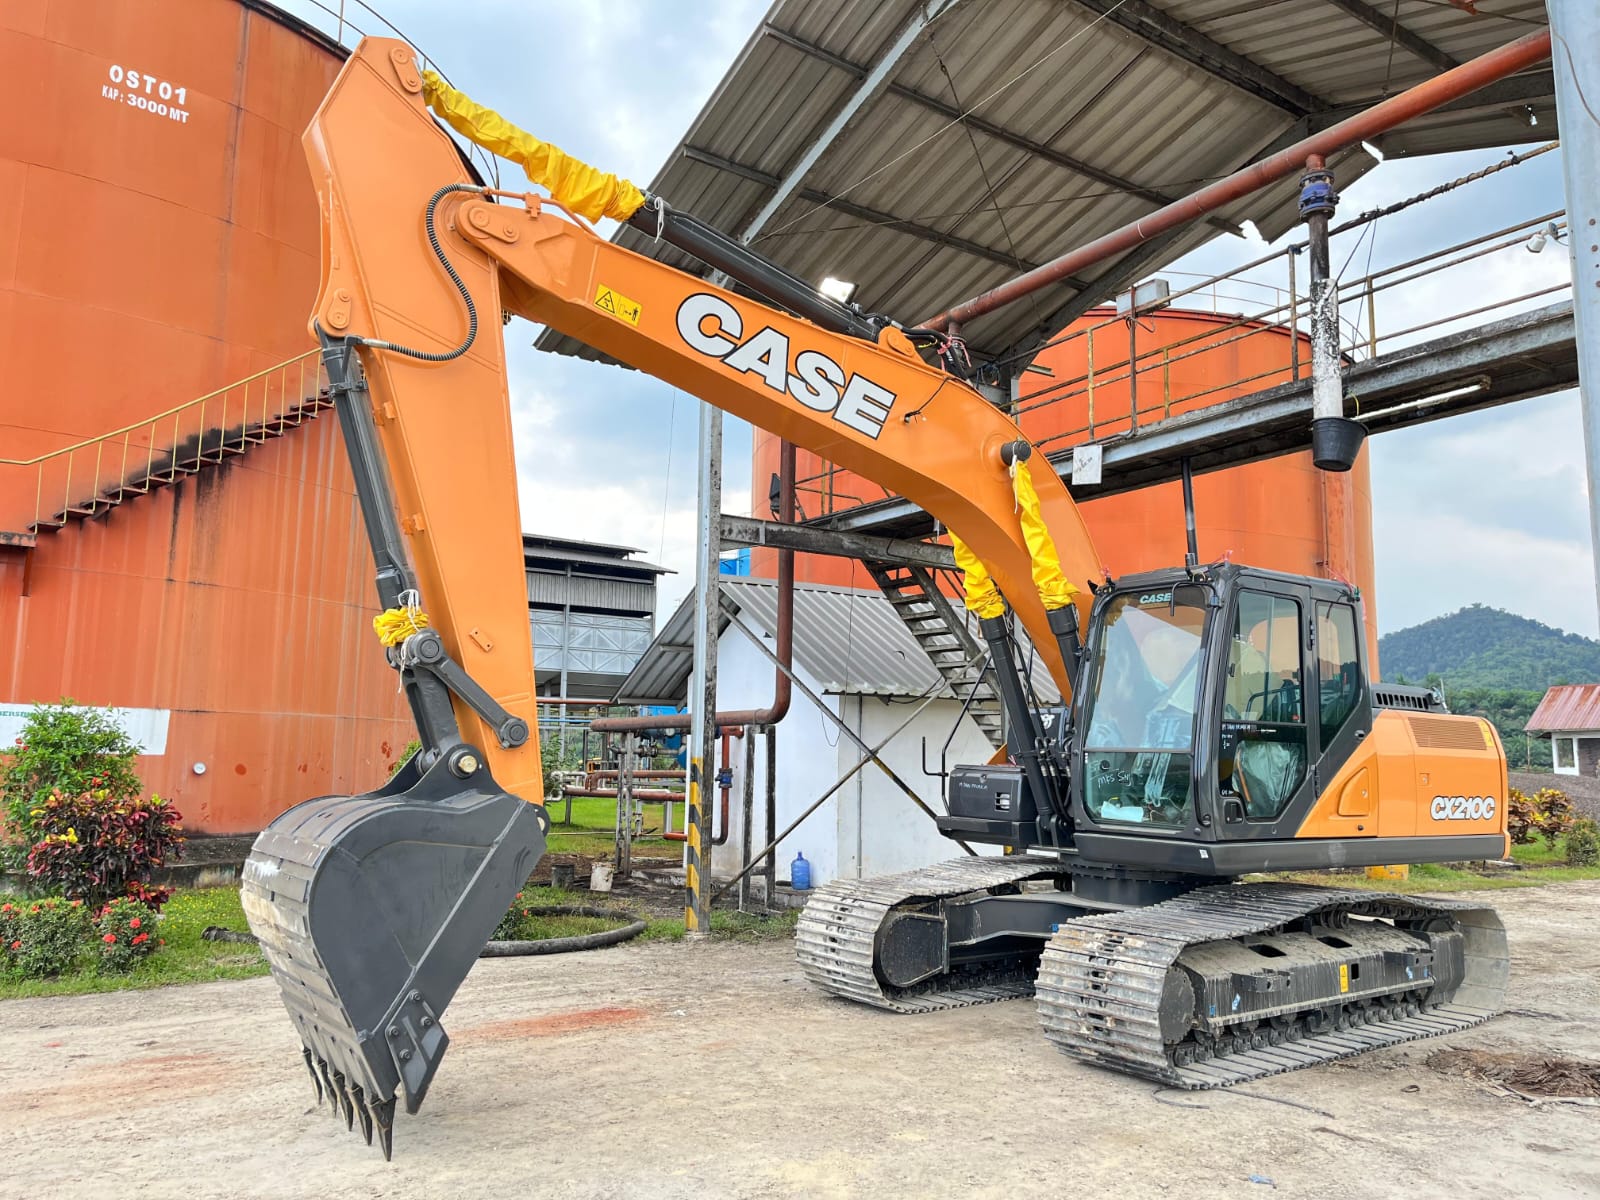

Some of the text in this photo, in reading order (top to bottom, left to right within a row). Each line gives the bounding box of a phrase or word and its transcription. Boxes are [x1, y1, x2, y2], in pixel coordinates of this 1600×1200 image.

[127, 93, 167, 116] 3000
[169, 106, 189, 123] MT
[676, 293, 897, 440] CASE
[1140, 592, 1172, 604] CASE
[1430, 796, 1495, 820] CX210C
